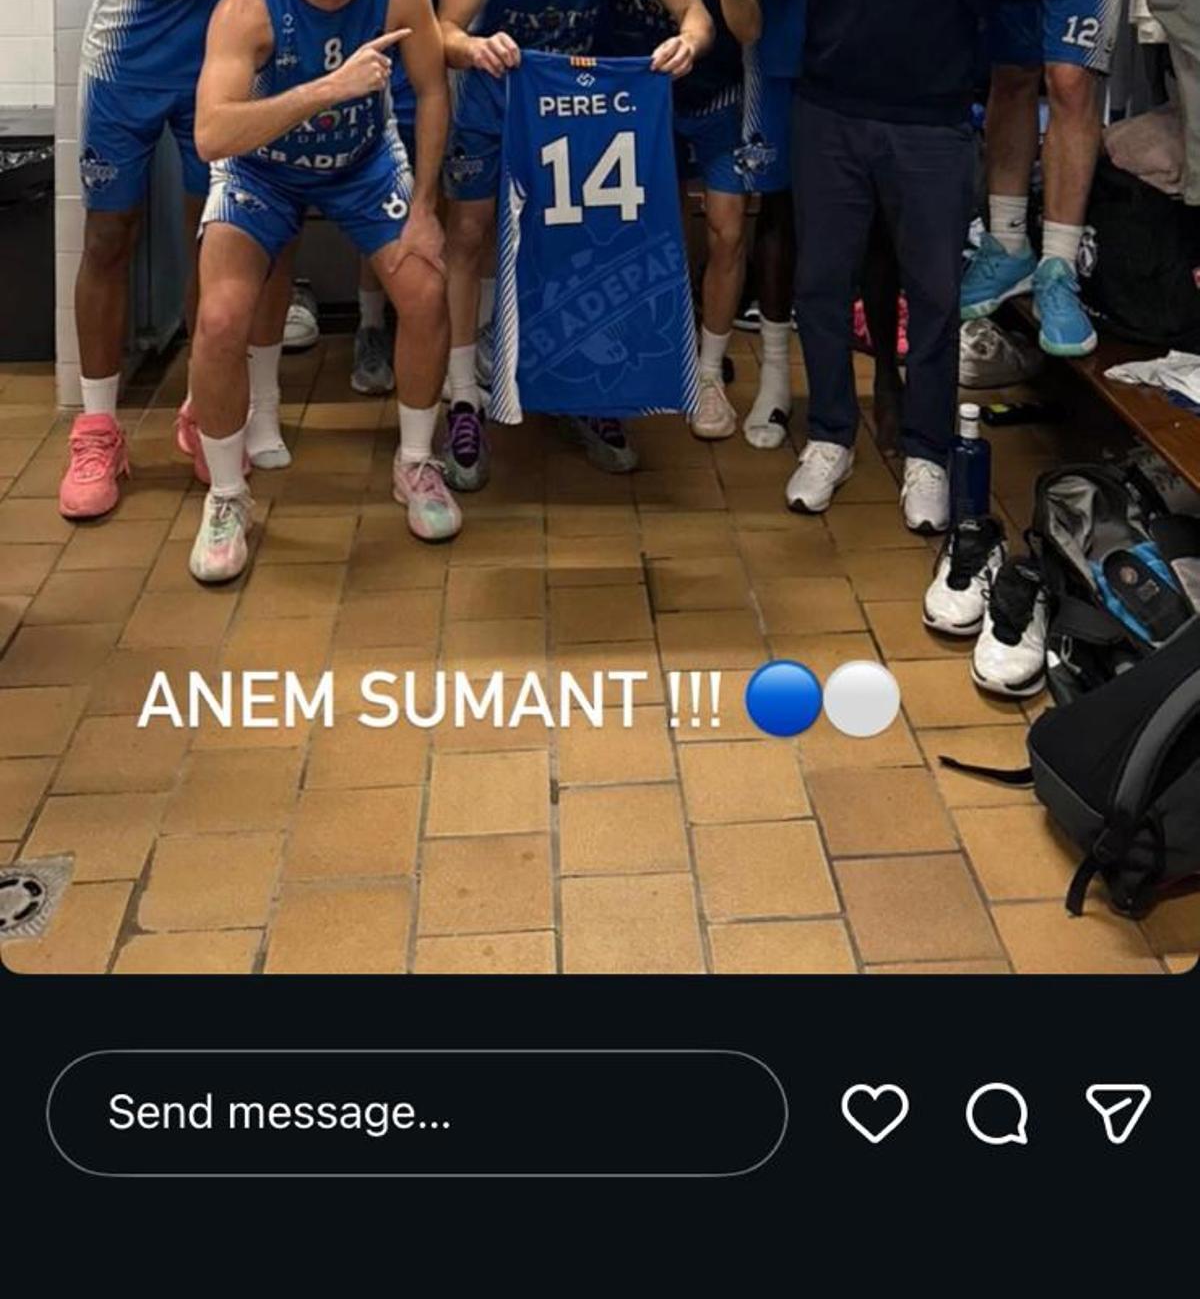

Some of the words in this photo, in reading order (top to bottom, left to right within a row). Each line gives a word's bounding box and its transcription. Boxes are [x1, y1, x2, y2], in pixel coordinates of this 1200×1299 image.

[1061, 14, 1099, 48] 12
[323, 37, 344, 70] 8
[539, 95, 607, 117] PERE
[613, 91, 637, 114] C.
[541, 131, 645, 226] 14
